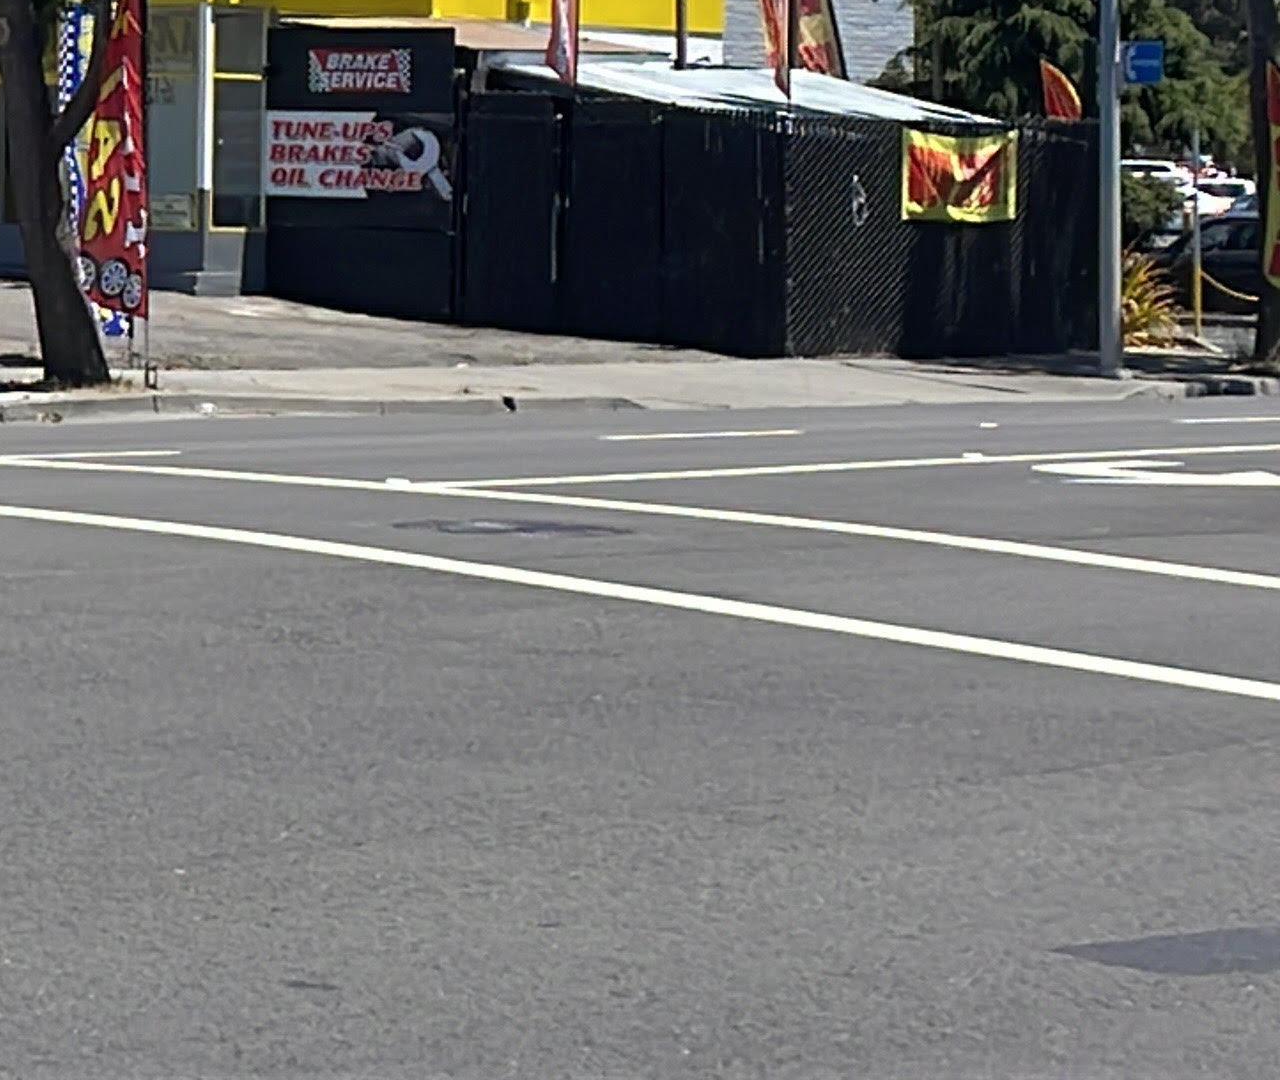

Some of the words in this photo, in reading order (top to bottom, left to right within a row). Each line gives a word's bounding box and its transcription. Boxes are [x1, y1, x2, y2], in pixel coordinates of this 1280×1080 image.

[326, 52, 391, 70] BRAKE
[320, 71, 400, 89] SERVICE
[271, 120, 392, 141] TUNE-UPS
[270, 143, 372, 164] BRAKES
[271, 166, 311, 188] OIL
[317, 167, 422, 191] CHANGE
